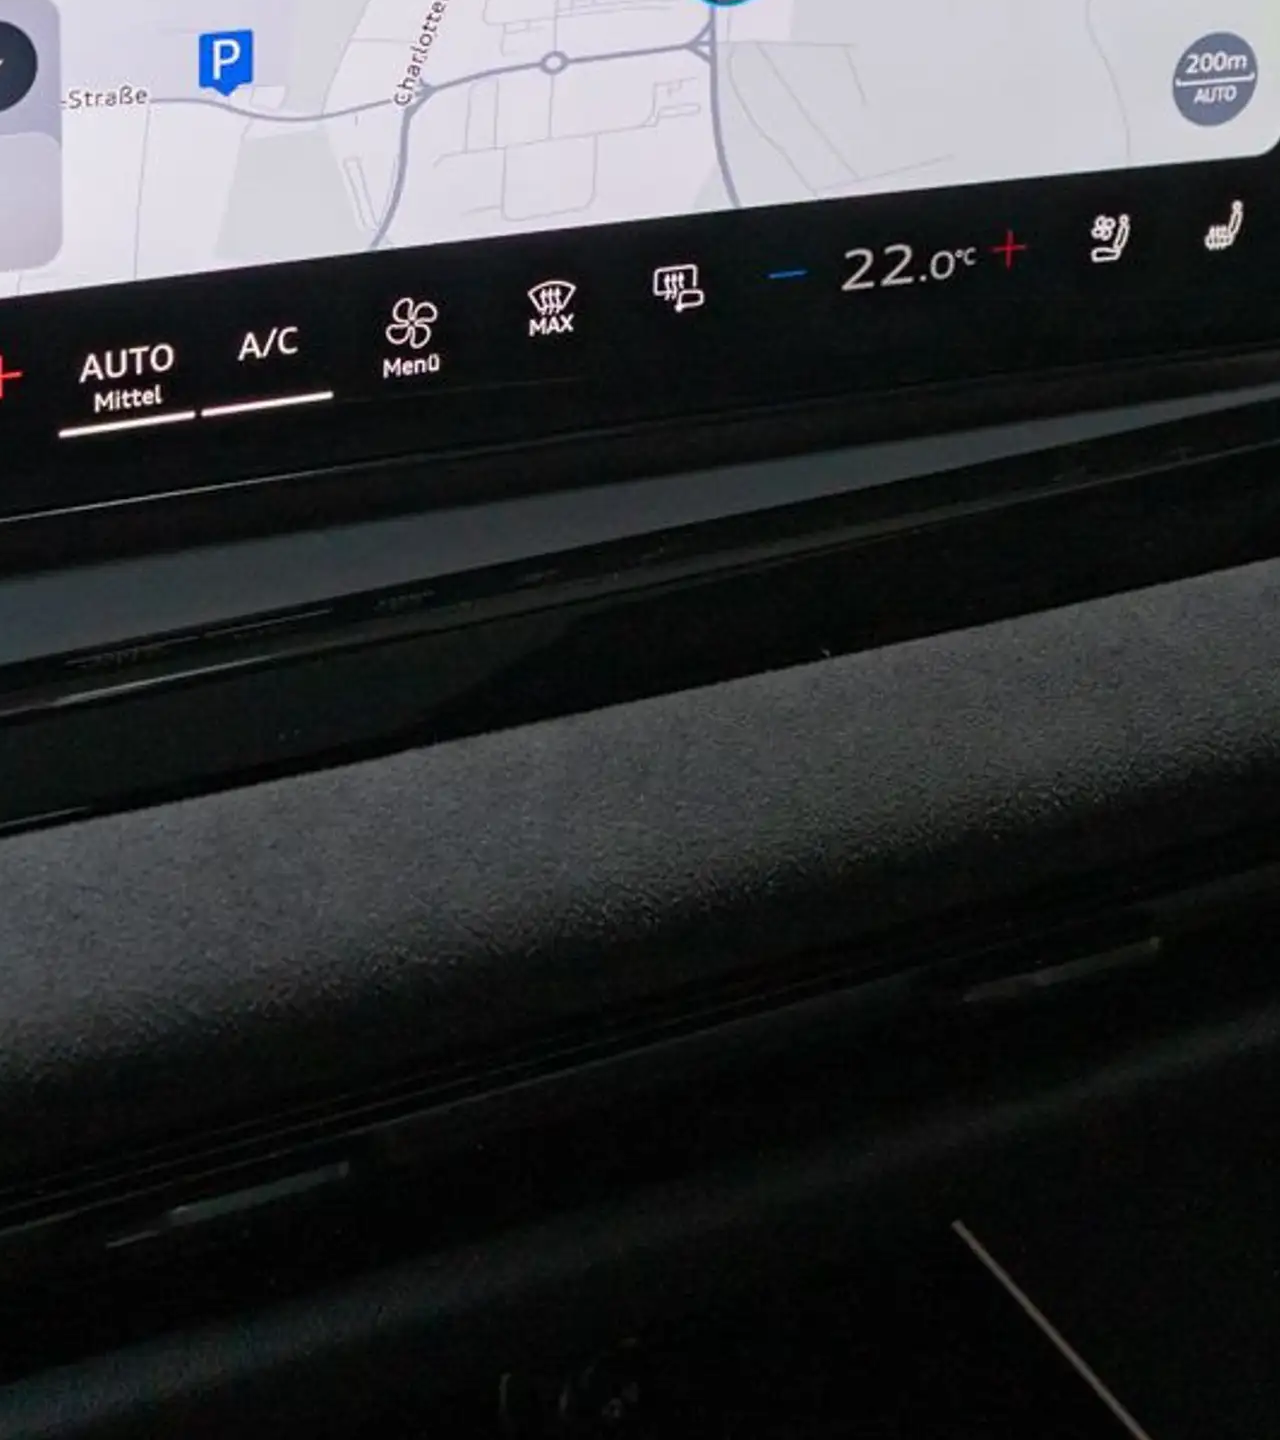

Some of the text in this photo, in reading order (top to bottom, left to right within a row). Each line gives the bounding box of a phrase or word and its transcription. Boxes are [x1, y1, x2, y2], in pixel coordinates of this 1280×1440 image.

[1184, 50, 1248, 75] 200m
[1193, 83, 1238, 104] AUTO
[529, 315, 574, 336] MAX
[237, 326, 298, 361] A/C
[79, 343, 174, 383] AUTO
[94, 387, 162, 413] Mittel
